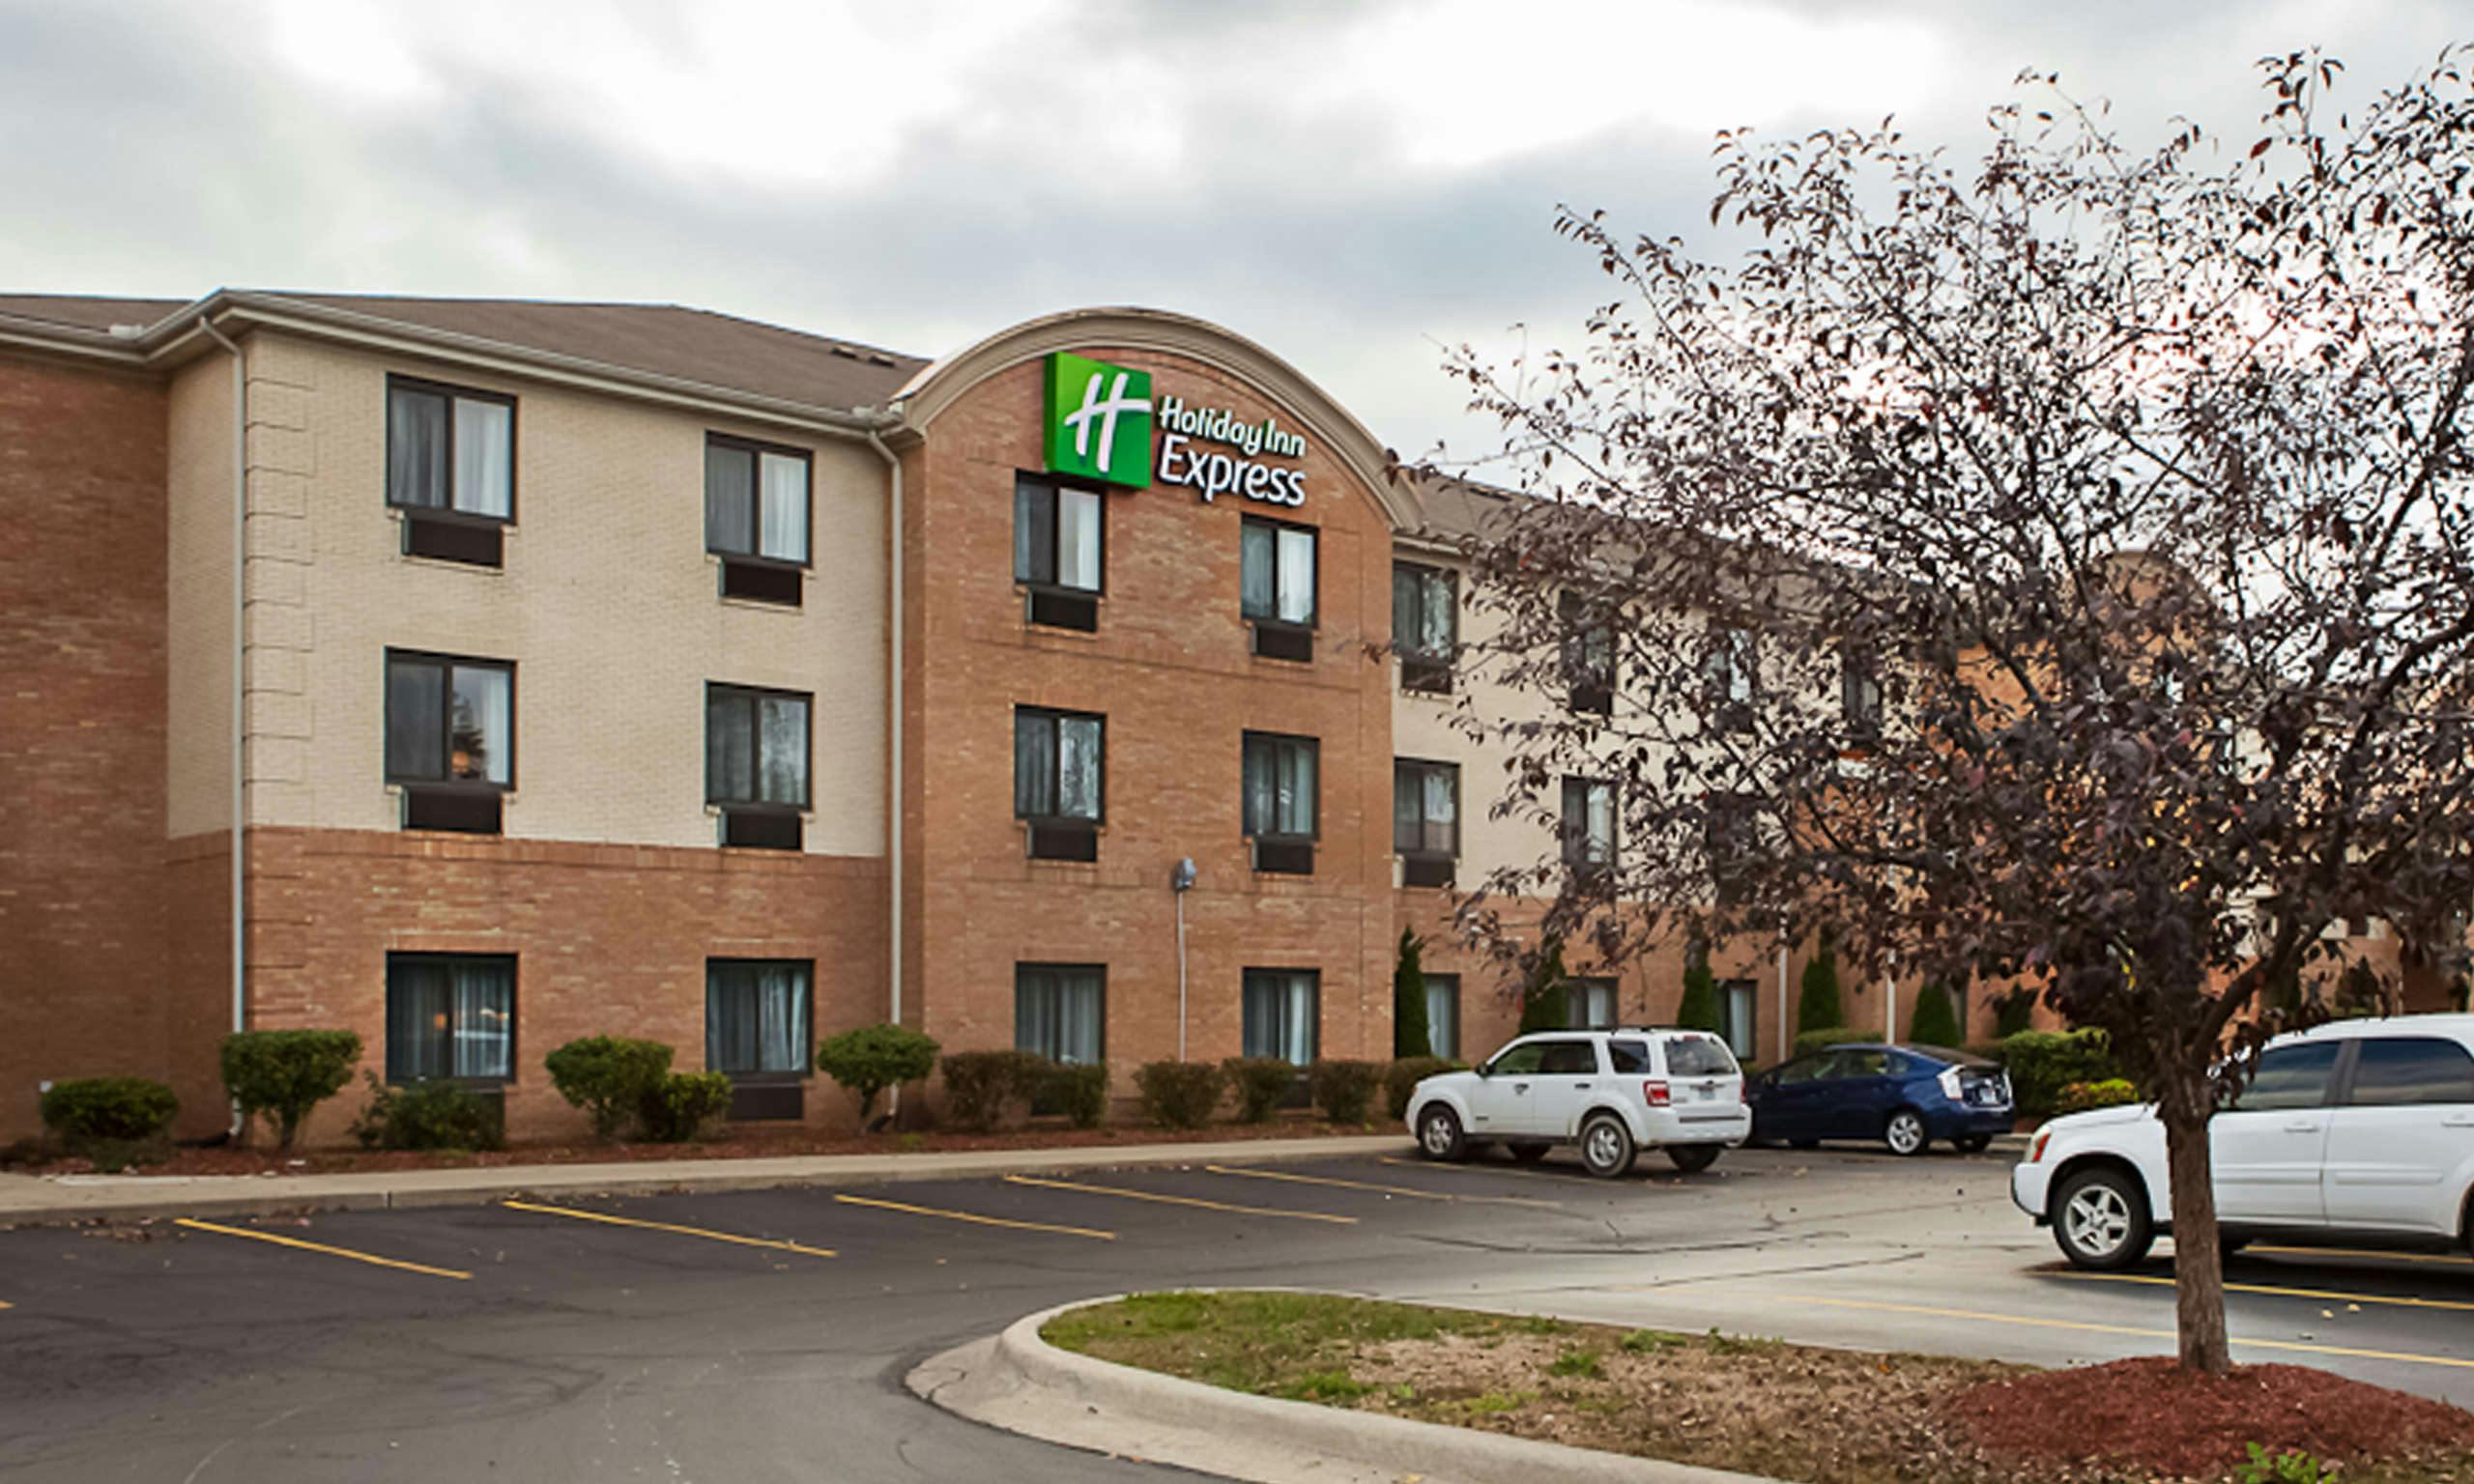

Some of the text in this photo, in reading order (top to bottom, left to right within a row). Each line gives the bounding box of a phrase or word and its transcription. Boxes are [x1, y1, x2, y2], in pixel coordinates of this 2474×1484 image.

[1064, 373, 1152, 472] H
[1159, 394, 1307, 458] Holiday Inn
[1159, 433, 1307, 507] Express
